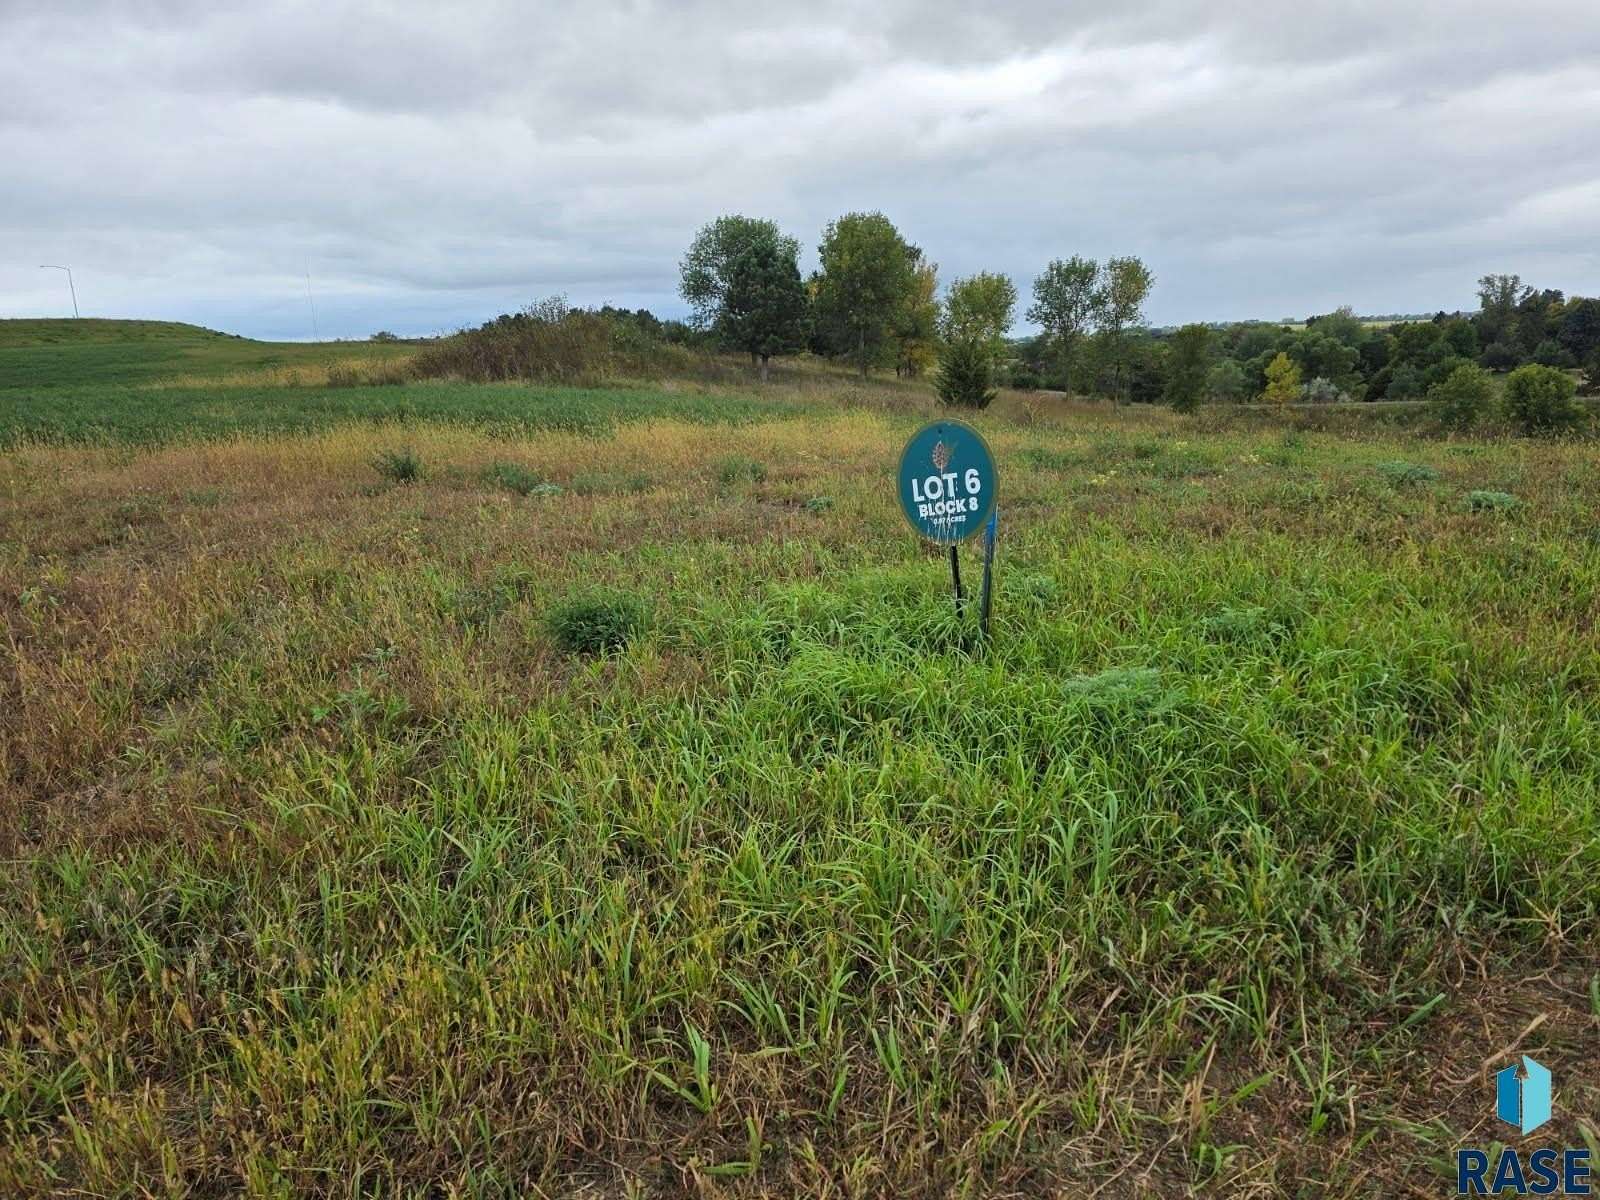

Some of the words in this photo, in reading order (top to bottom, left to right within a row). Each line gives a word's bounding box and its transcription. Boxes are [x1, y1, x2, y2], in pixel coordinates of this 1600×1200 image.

[912, 473, 957, 502] LOT
[965, 469, 980, 494] 6
[919, 499, 966, 517] BLOCK
[969, 497, 978, 511] 8
